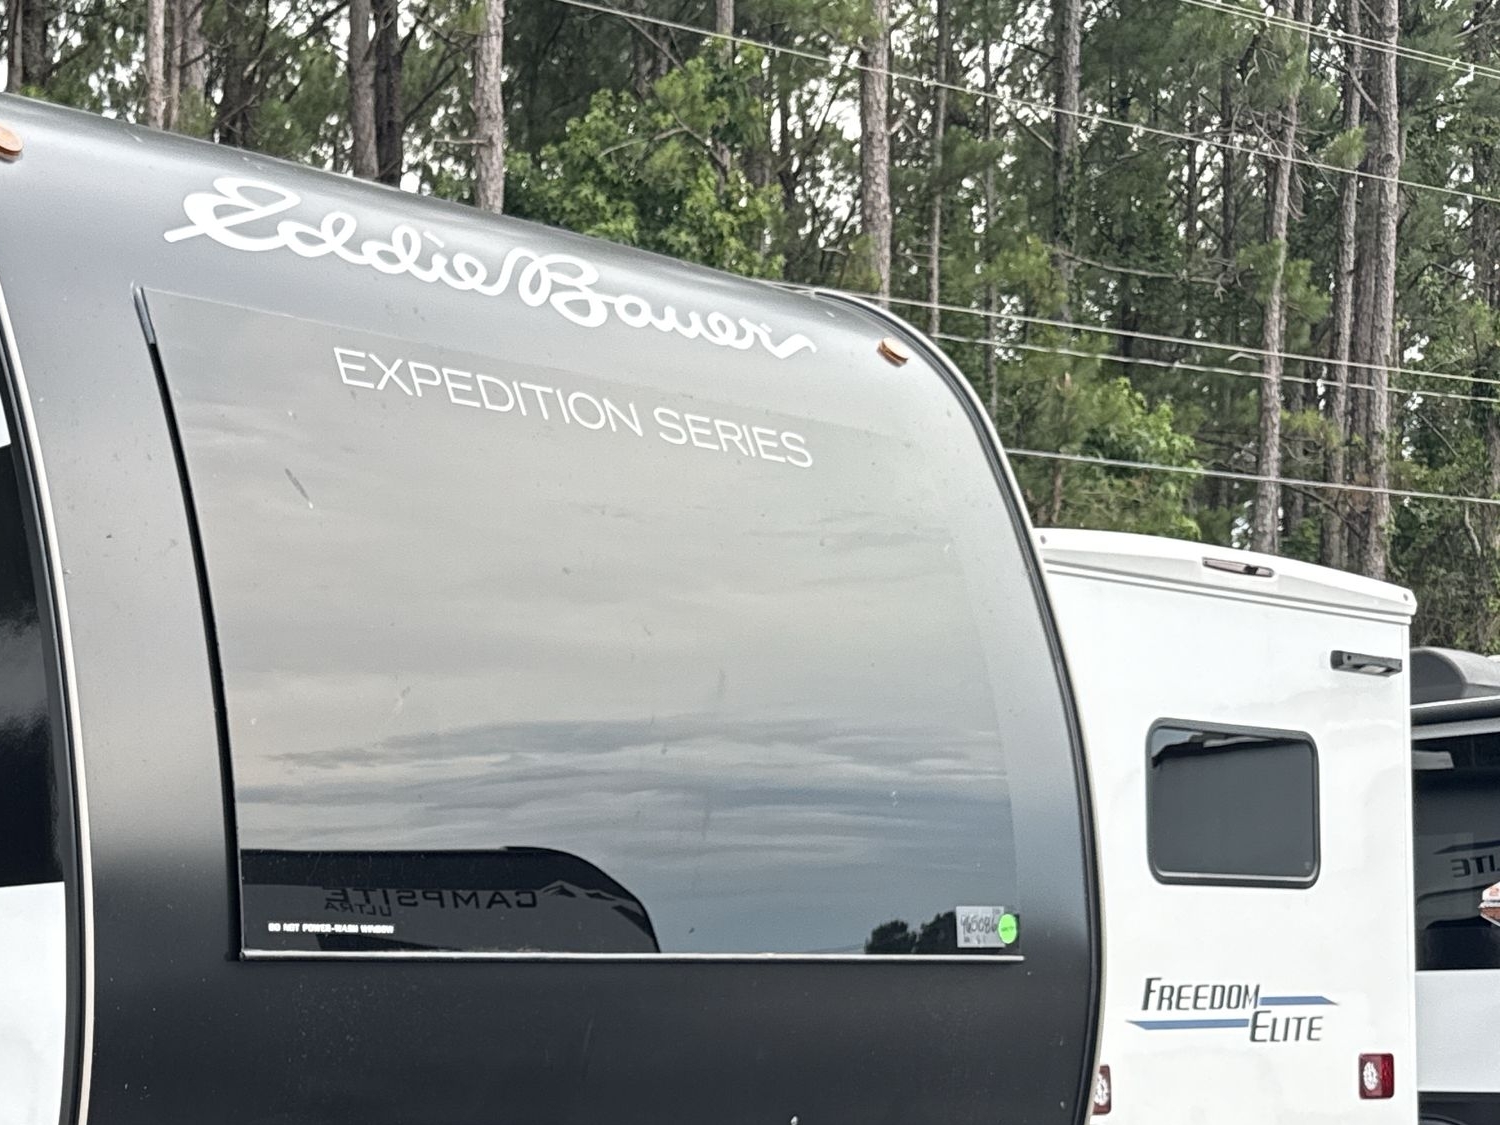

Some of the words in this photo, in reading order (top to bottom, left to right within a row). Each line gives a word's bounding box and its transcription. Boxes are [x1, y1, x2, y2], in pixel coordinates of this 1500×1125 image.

[164, 177, 503, 296] Eddie
[501, 247, 816, 359] Bauer
[334, 346, 643, 437] EXPEDITION
[654, 407, 814, 468] SERIES
[283, 923, 300, 932] NOT
[1141, 977, 1260, 1011] FREEDOM
[1250, 1010, 1323, 1042] ELITE
